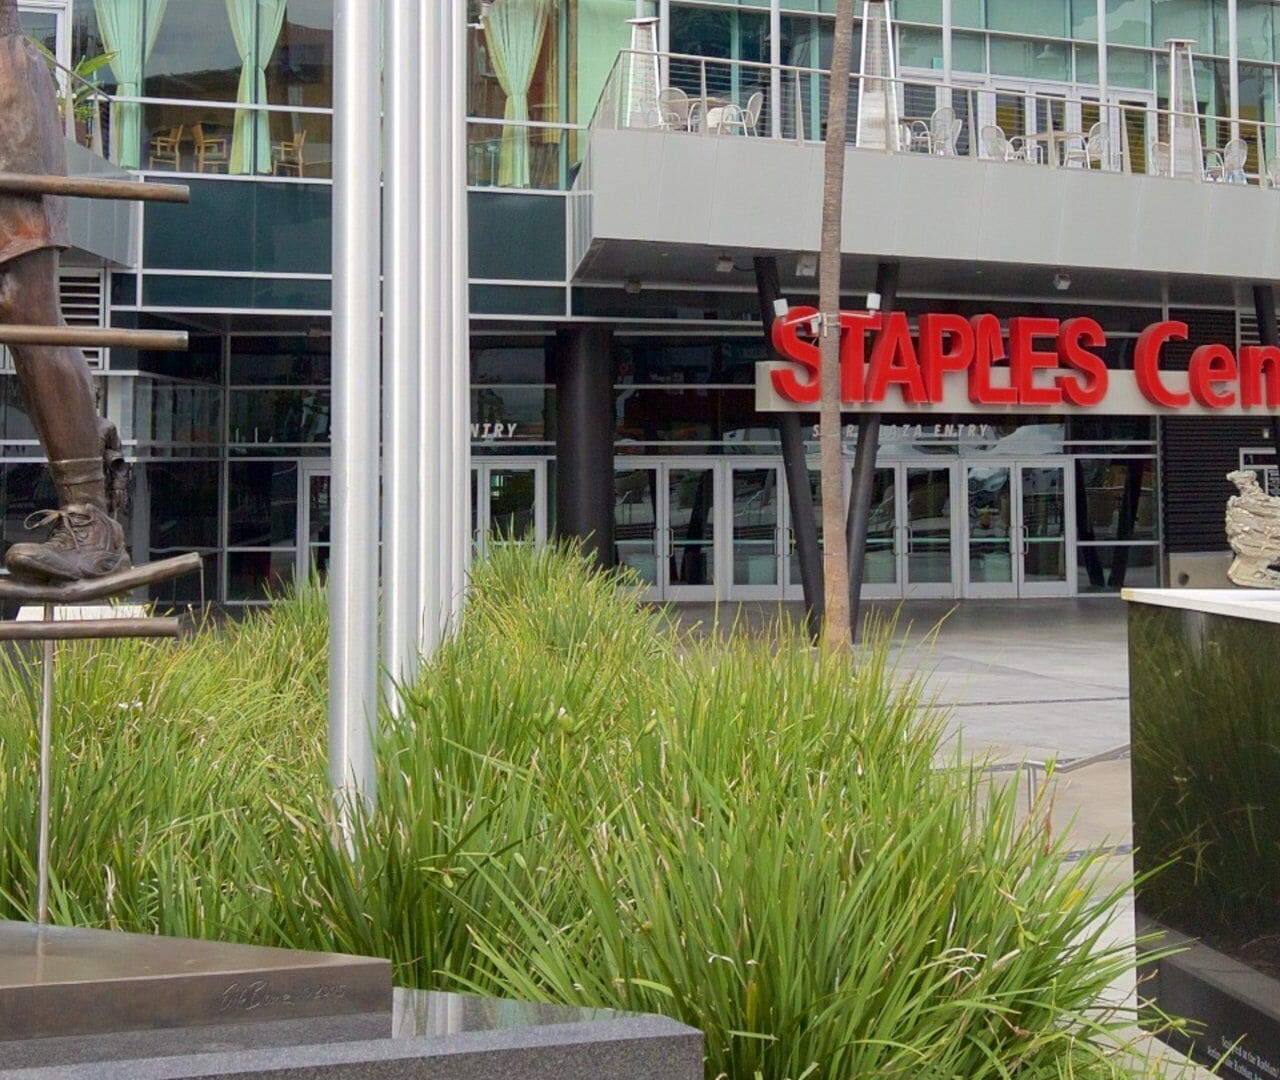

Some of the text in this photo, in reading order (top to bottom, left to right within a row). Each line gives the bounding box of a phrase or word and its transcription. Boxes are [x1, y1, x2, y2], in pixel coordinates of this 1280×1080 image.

[770, 305, 1109, 408] STAPLES
[470, 423, 517, 438] NTRY
[812, 423, 854, 438] SR
[934, 423, 988, 438] ENTRY
